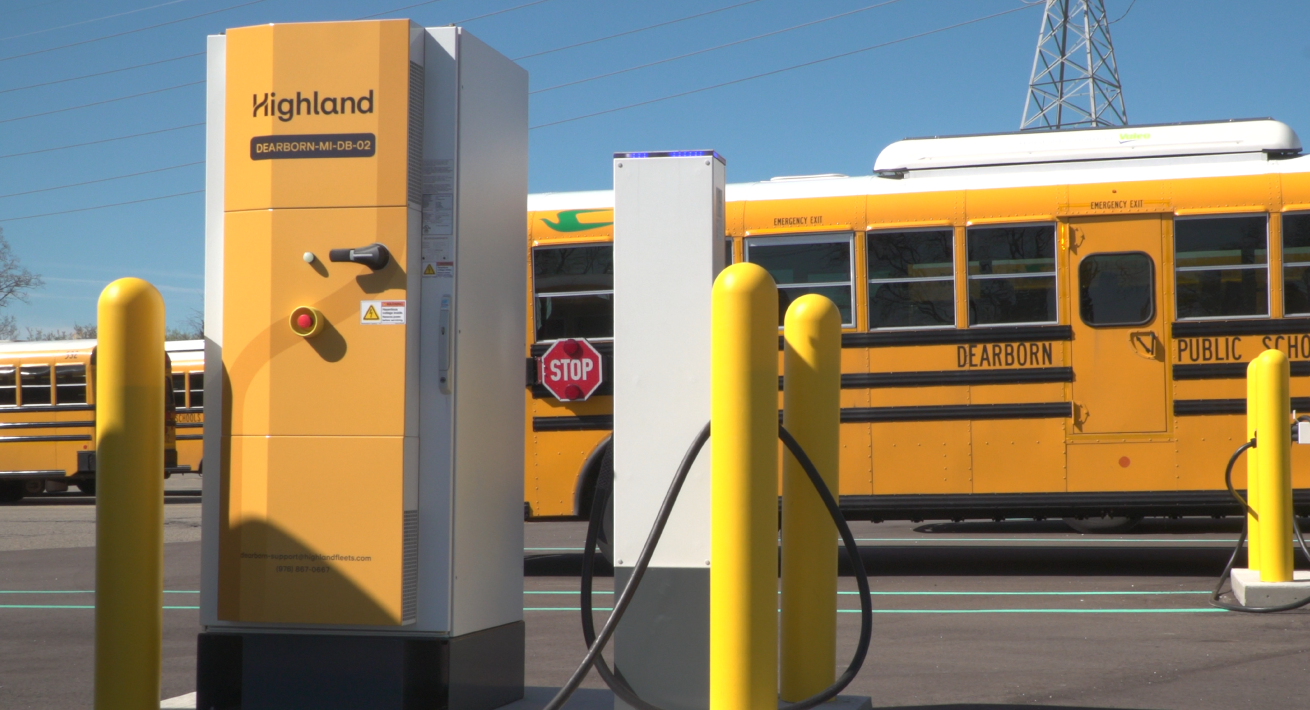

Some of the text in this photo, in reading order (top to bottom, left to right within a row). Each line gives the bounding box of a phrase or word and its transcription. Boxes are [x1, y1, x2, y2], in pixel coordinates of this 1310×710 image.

[253, 89, 374, 122] Highland
[256, 140, 371, 153] DEARBORN-MI-DB-02
[1090, 199, 1143, 210] EMERGENCY EXIT
[773, 215, 823, 226] EMERGENCY EXIT
[957, 342, 1053, 368] DEARBORN
[1177, 336, 1243, 363] PUBLIC
[550, 358, 594, 382] STOP
